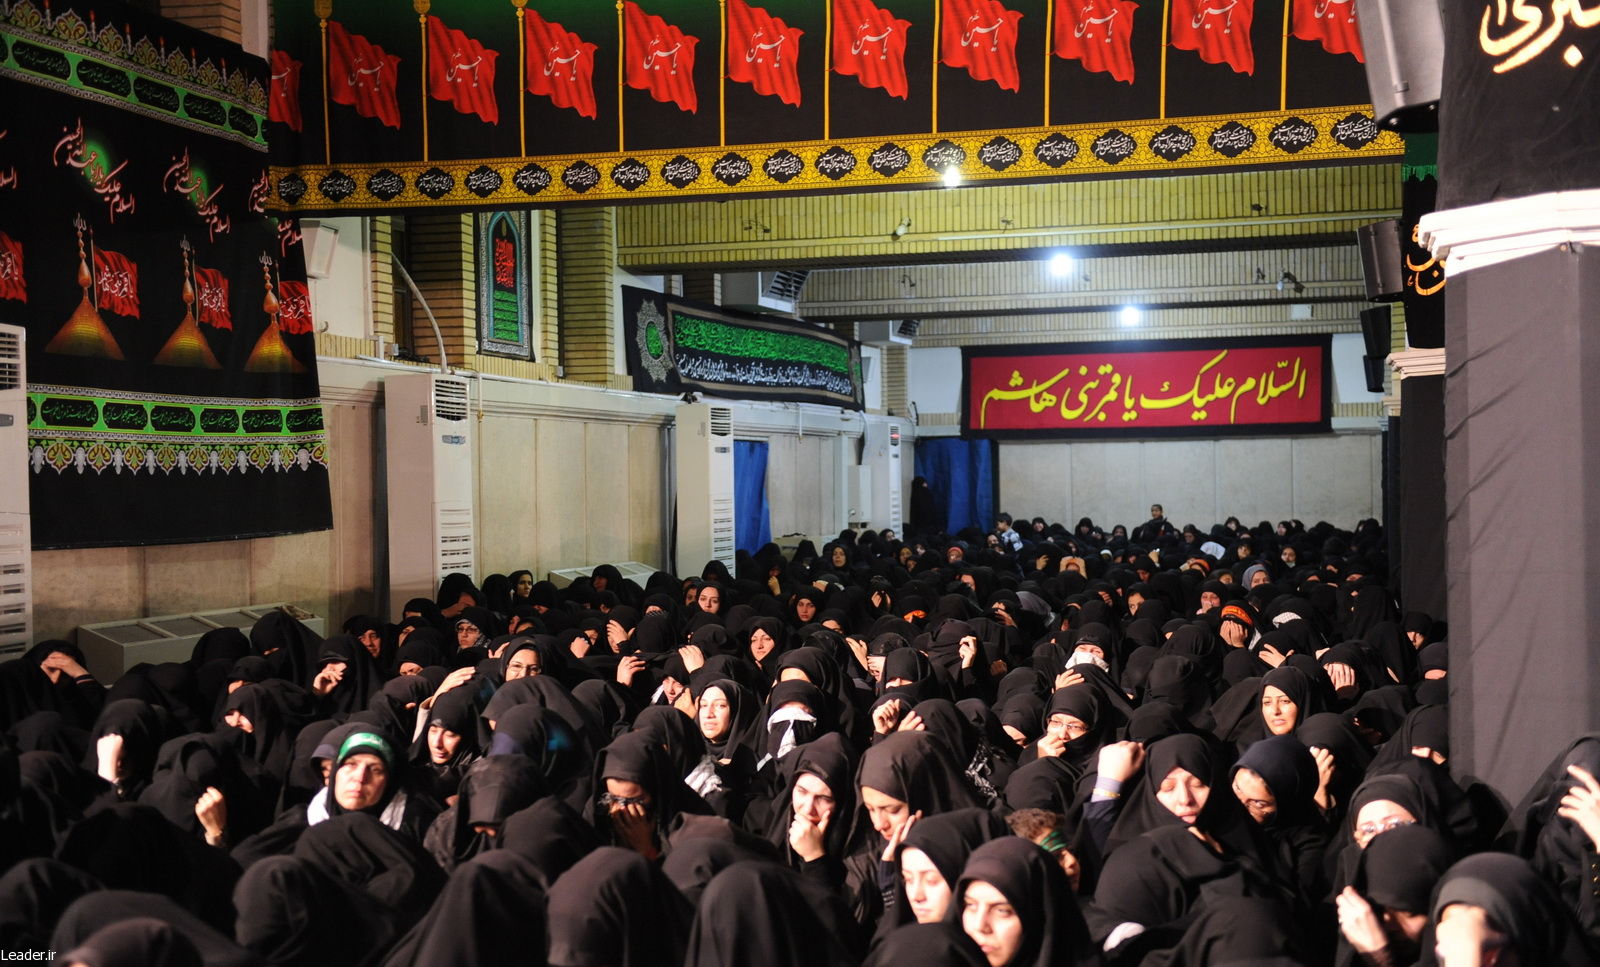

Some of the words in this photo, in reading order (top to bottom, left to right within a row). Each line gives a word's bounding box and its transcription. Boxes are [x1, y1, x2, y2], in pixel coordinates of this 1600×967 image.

[981, 368, 1070, 429] هاشم
[1082, 364, 1122, 423] قمر
[1121, 375, 1138, 423] یا
